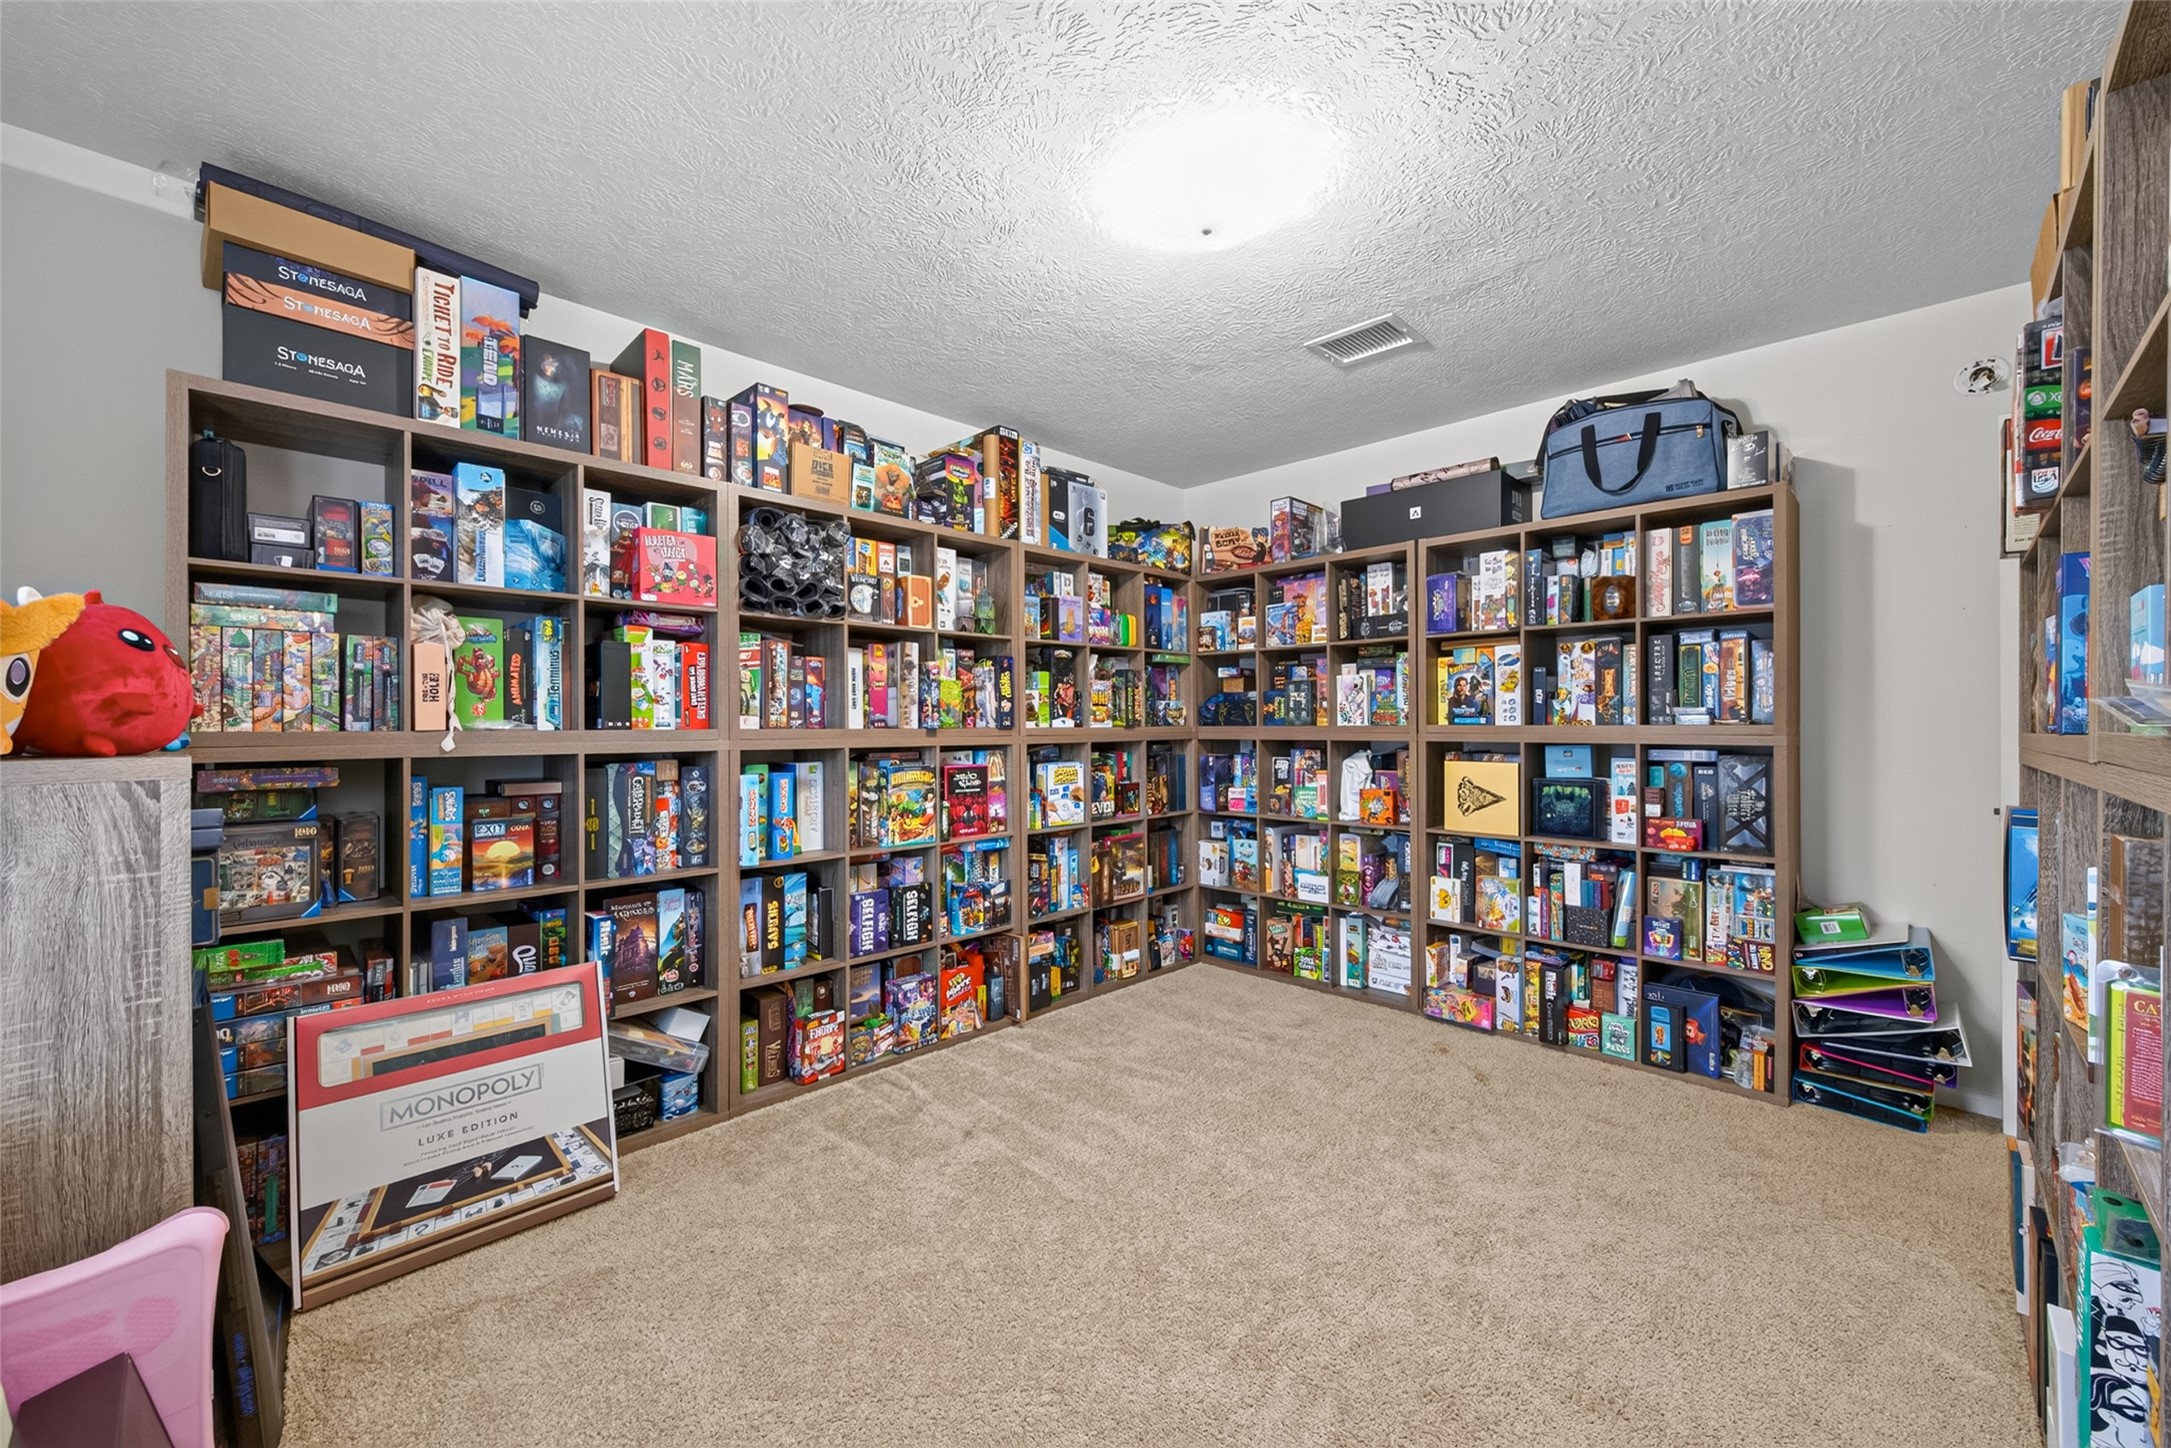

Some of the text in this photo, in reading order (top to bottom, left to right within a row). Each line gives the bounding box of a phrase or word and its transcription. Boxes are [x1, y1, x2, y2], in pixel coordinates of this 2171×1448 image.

[278, 265, 367, 302] STONESAGA
[283, 295, 371, 331] STONESAGA
[277, 345, 366, 379] STONESAGA
[435, 352, 457, 389] RIDE
[677, 359, 699, 399] MARS
[389, 1070, 535, 1124] MONOPOLY
[418, 1129, 454, 1147] LUXE
[462, 1111, 519, 1134] EDITION
